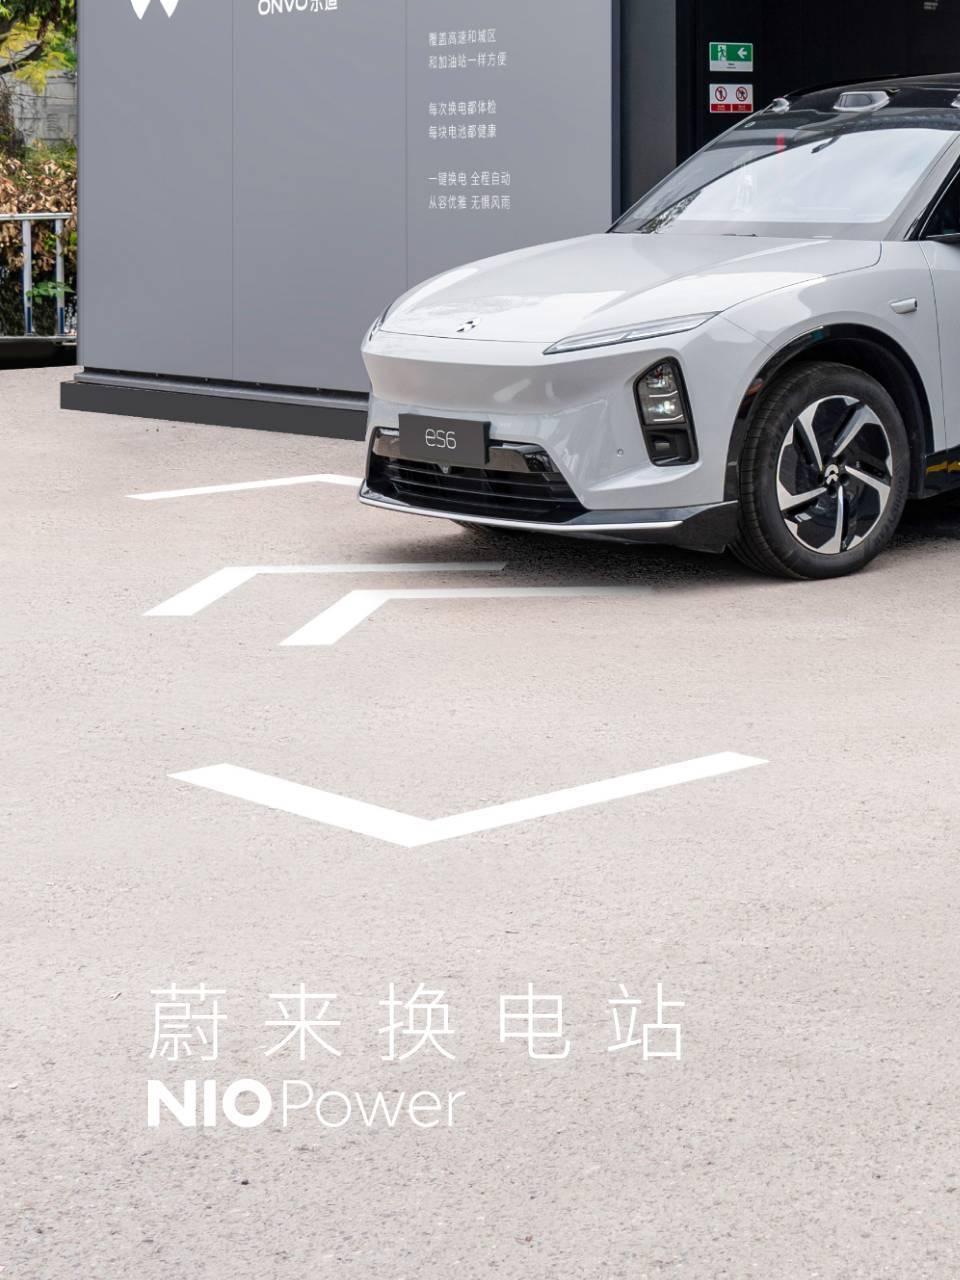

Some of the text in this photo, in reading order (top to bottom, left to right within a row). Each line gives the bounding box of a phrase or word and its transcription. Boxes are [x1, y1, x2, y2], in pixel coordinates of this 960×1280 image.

[428, 51, 508, 69] 和加油站一样方便
